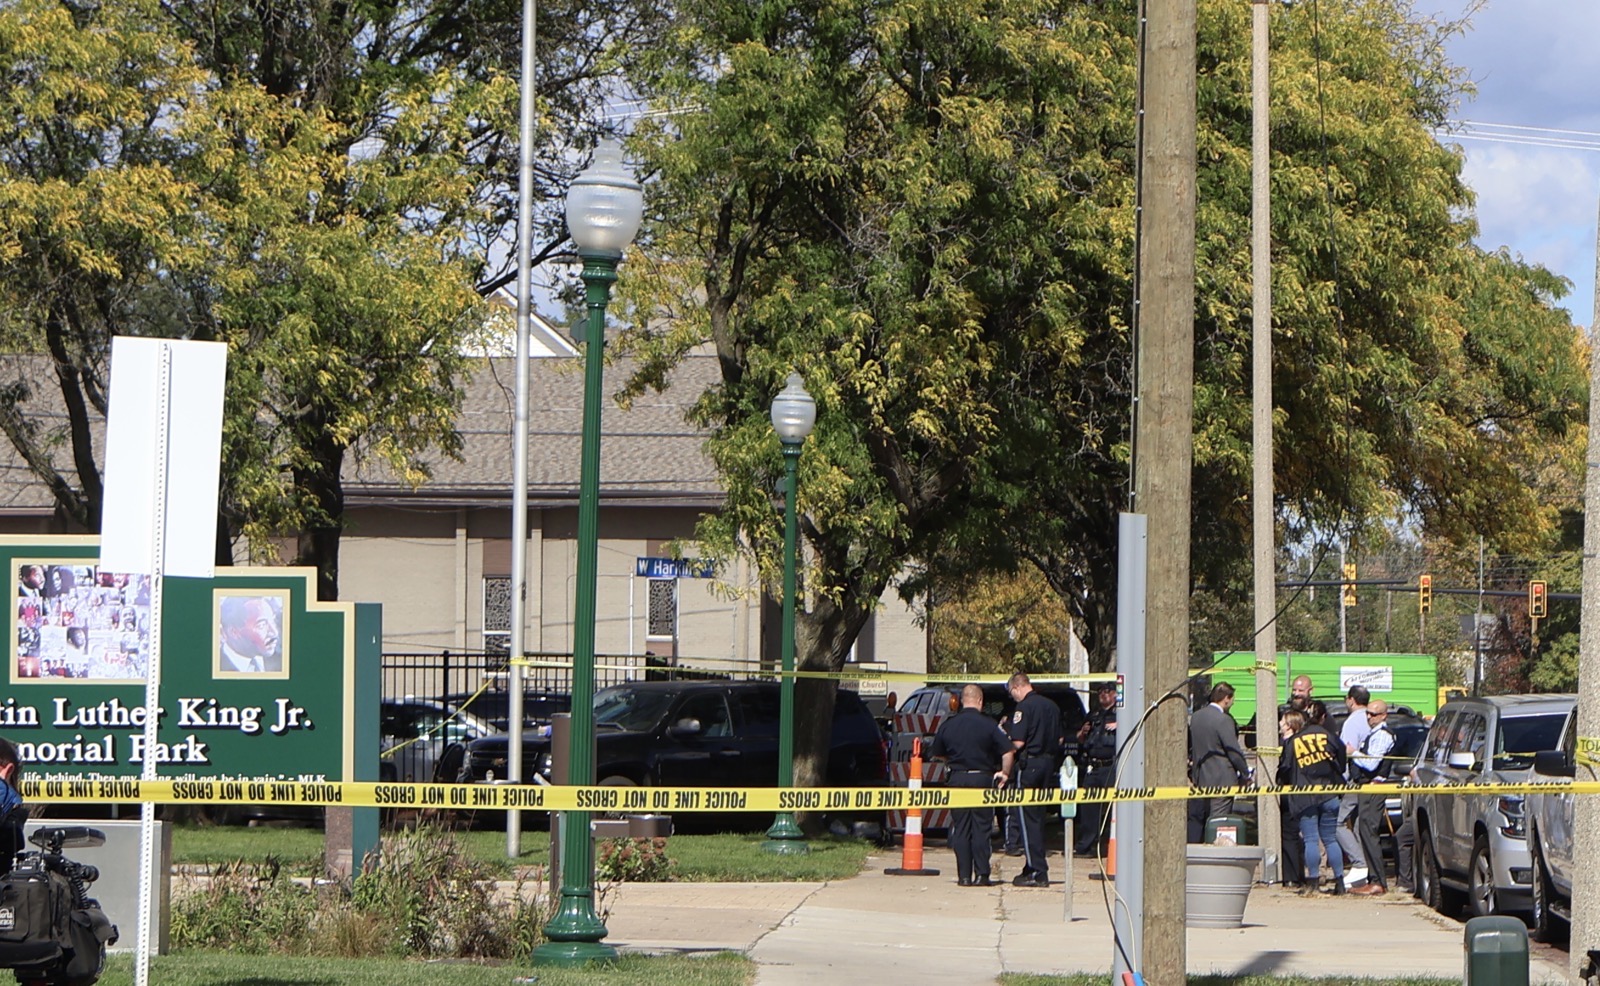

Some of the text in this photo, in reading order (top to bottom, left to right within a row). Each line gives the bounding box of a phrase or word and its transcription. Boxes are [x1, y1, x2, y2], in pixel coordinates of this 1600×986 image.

[639, 560, 648, 574] W
[178, 698, 262, 732] King
[270, 699, 312, 732] Jr.
[1294, 733, 1327, 758] ATF
[175, 773, 195, 781] will
[46, 781, 63, 797] DO
[69, 781, 94, 797] LINE
[99, 781, 140, 798] POLICE
[173, 782, 343, 802] POLICE LINE DO NOT CROSS
[375, 785, 544, 806] POLICE LINE DO NOT CROSS
[982, 787, 1156, 804] POLICE LINE DO NOT CROSS
[576, 789, 747, 809] POLICE LINE DO NOT CROSS
[779, 789, 950, 808] POLICE LINE DO NOT CROSS
